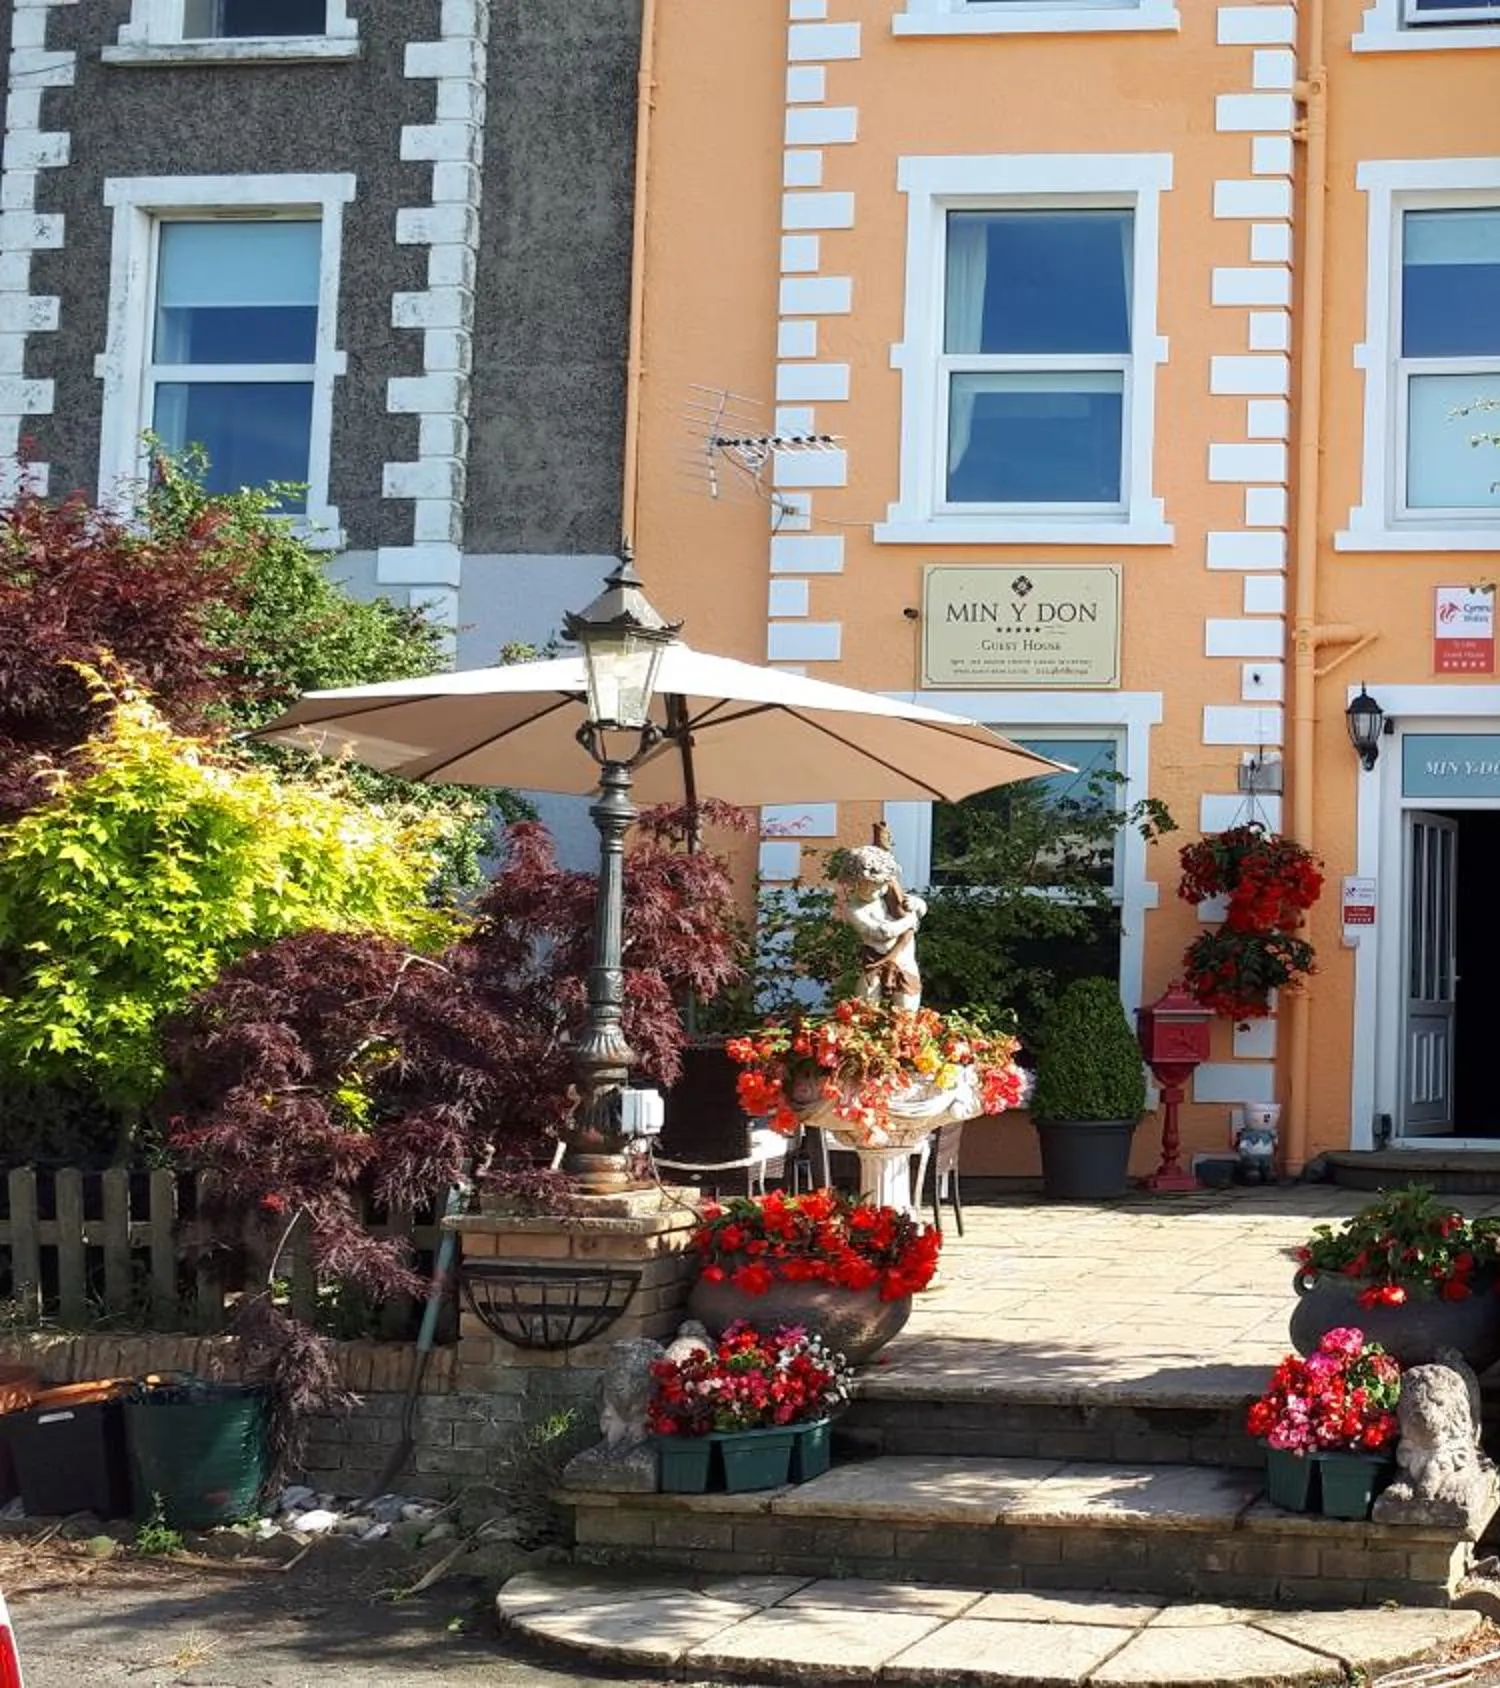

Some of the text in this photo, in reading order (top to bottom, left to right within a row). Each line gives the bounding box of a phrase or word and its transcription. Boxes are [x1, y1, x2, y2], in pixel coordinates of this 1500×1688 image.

[946, 603, 1097, 623] MIN Y DON
[1424, 760, 1459, 775] MIN
